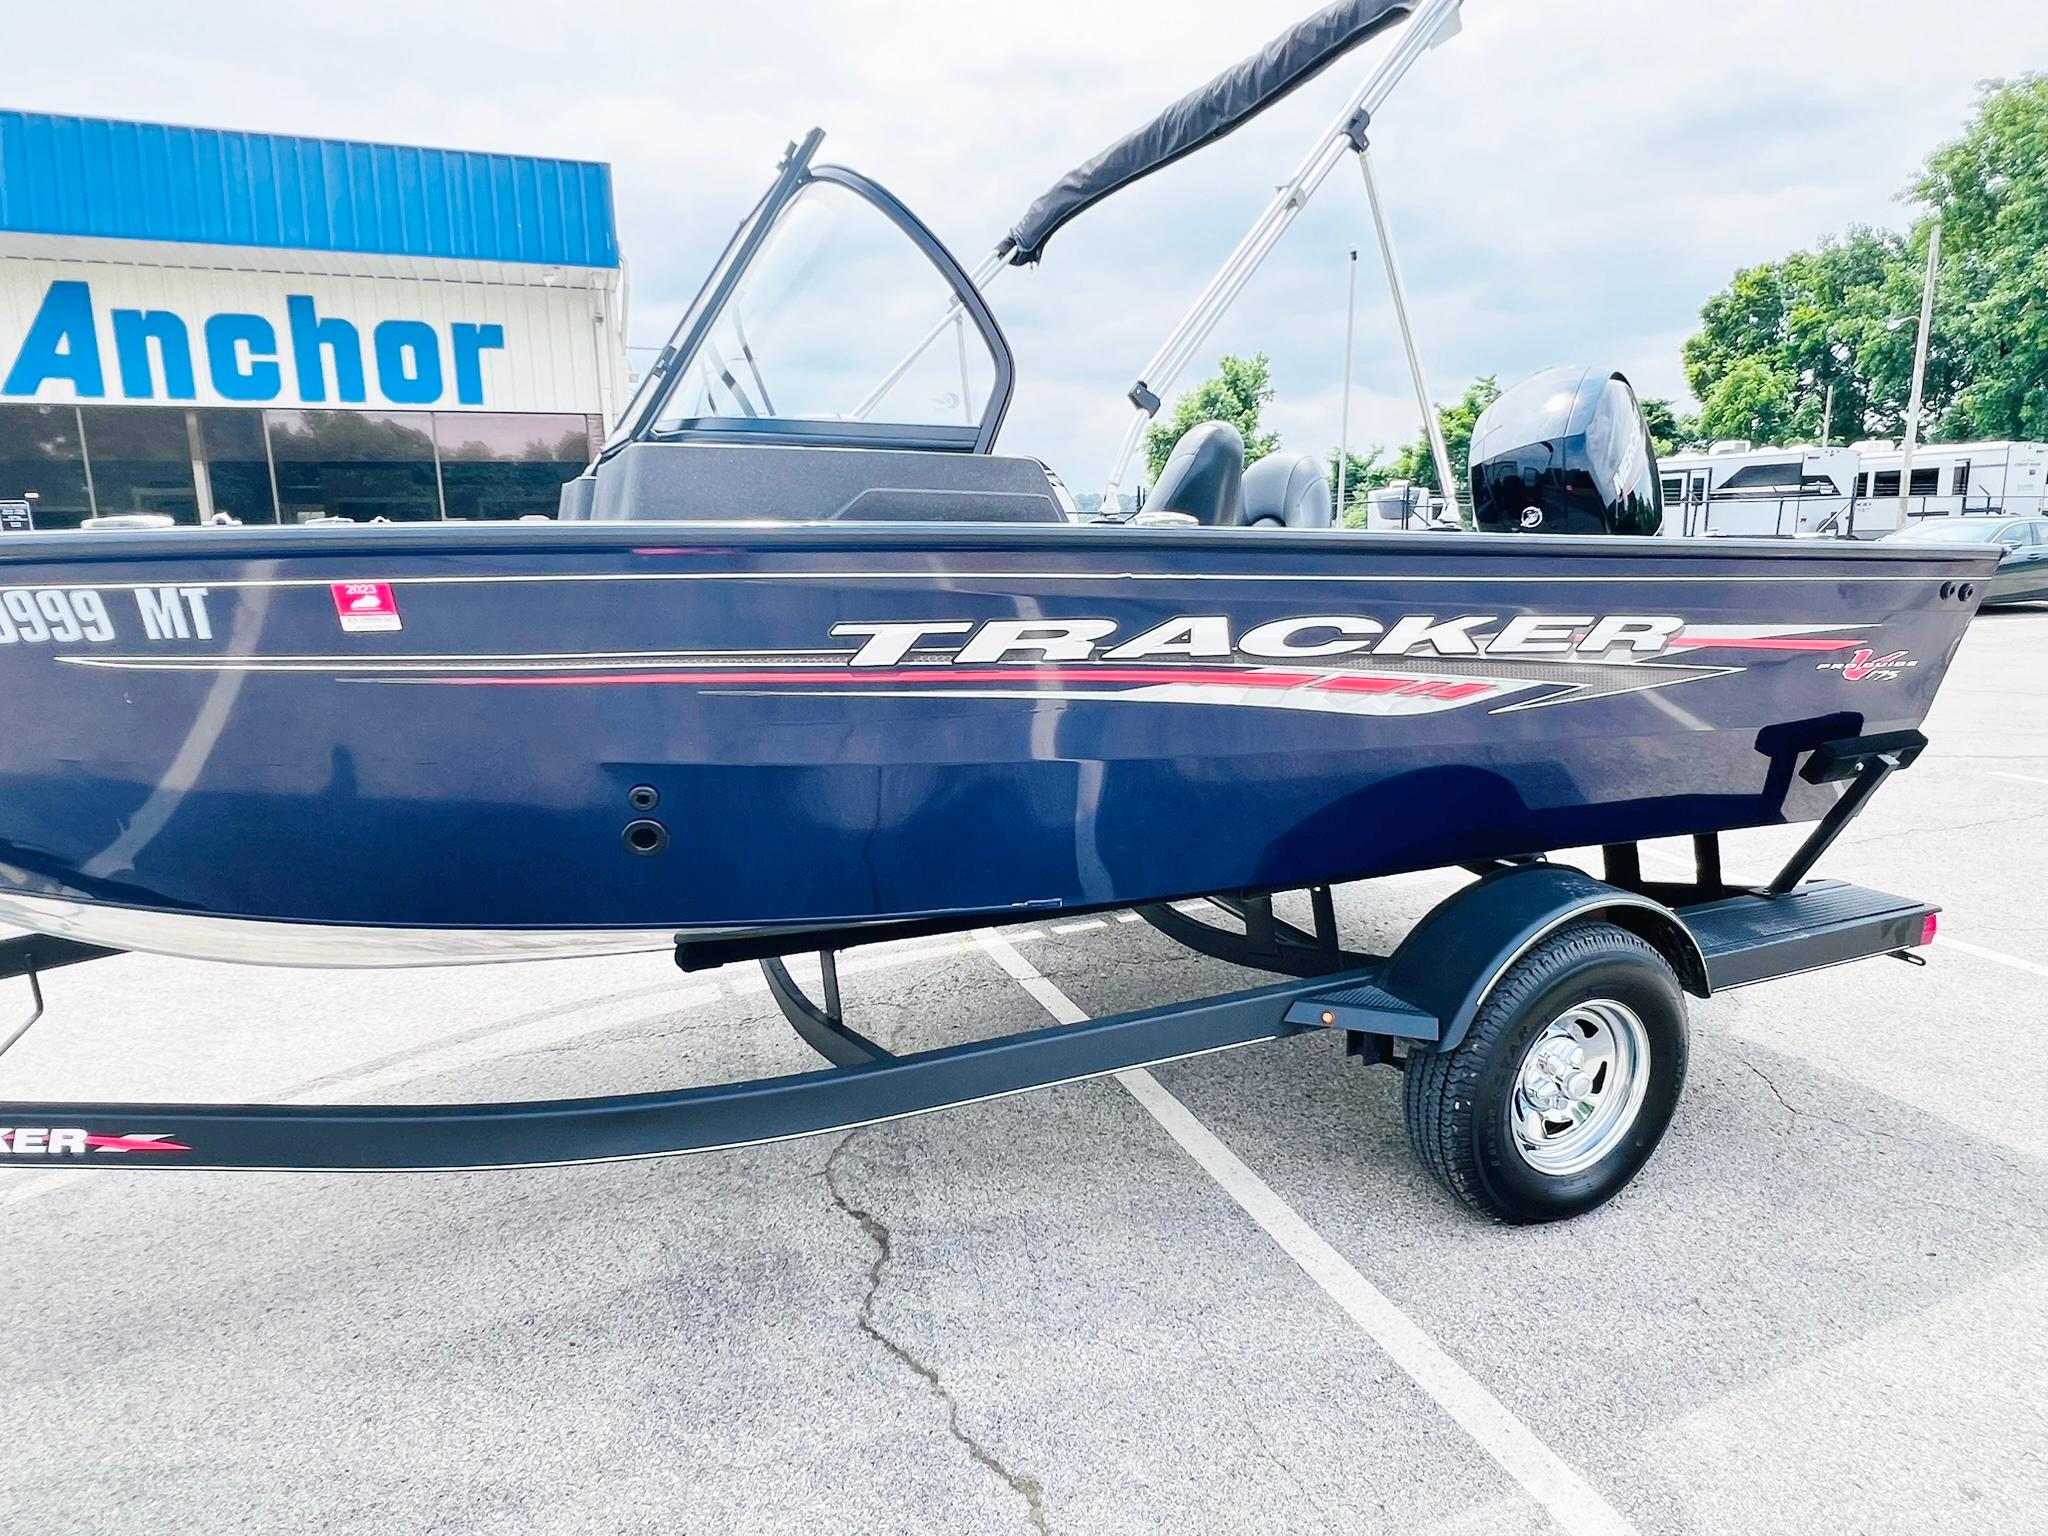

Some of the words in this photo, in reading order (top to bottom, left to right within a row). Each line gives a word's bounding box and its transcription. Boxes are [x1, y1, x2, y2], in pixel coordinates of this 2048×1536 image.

[2, 280, 504, 405] Anchor
[134, 588, 213, 639] MT
[344, 584, 378, 595] 2023
[829, 613, 1685, 667] TRACKER
